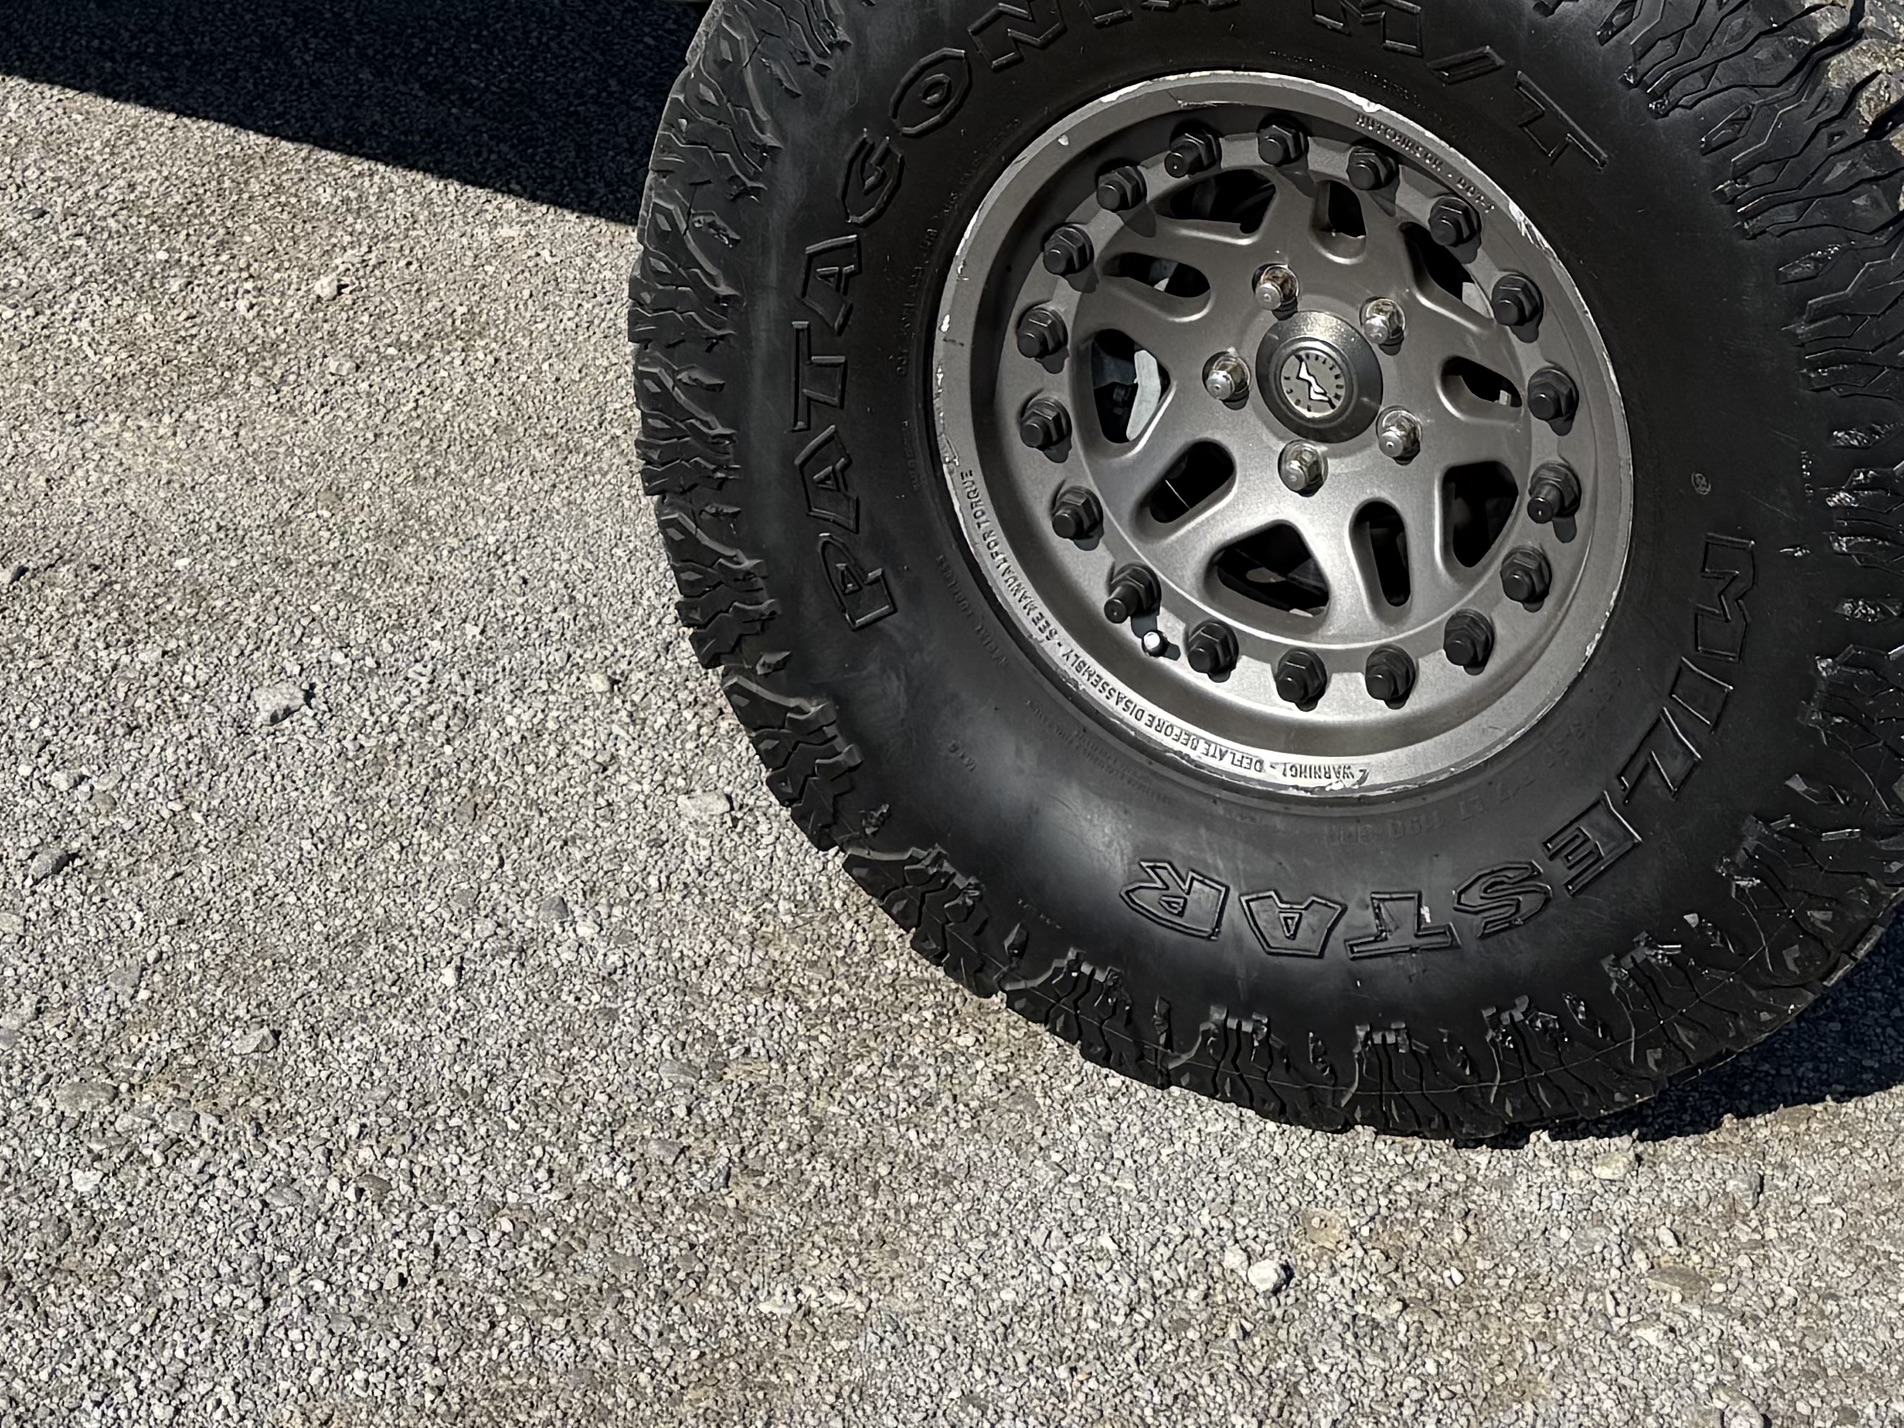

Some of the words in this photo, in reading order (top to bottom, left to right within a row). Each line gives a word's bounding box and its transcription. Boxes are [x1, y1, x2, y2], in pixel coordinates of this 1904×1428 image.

[959, 470, 991, 537] TORQUE
[980, 528, 1004, 558] FOR
[993, 554, 1038, 616] MANUAL
[1028, 611, 1058, 642] SEE
[1061, 647, 1146, 723] DISASSEMBLY
[1120, 530, 1758, 959] MILESTAR
[1143, 711, 1200, 751] BEFORE
[1200, 740, 1265, 775] DEFLATE
